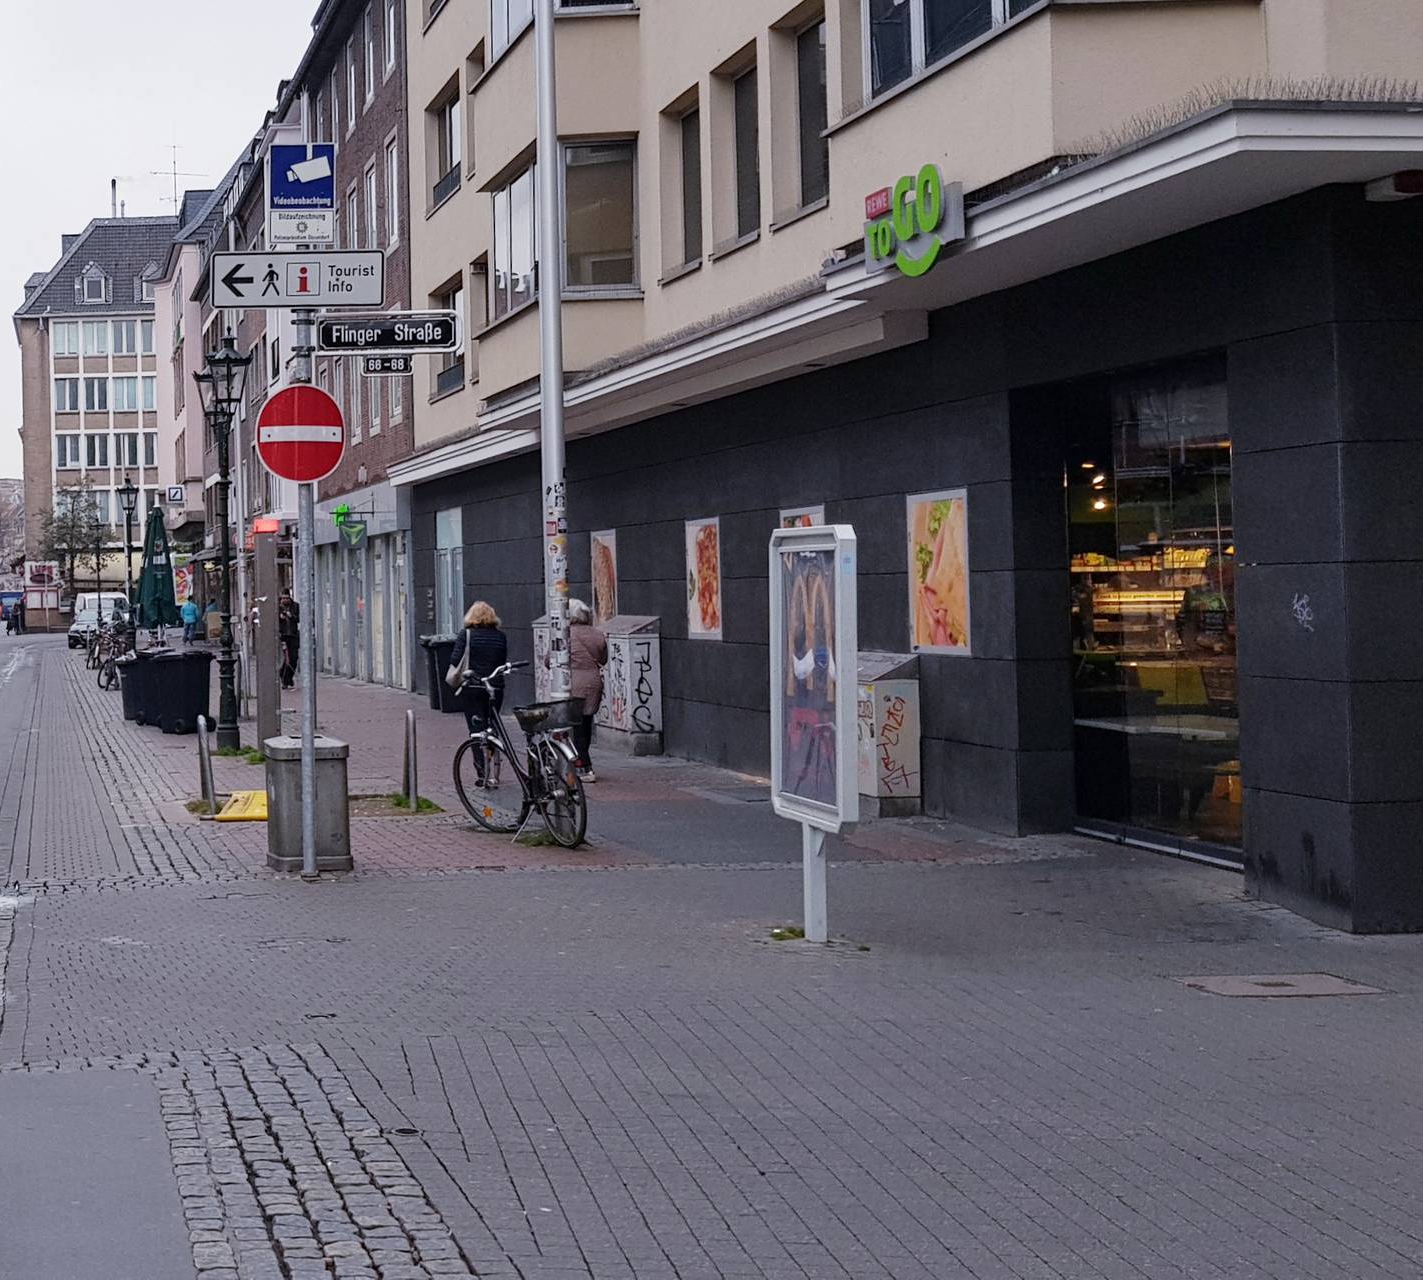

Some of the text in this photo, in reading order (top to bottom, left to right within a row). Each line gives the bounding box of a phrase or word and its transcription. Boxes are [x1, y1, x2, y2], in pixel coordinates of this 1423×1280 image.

[328, 265, 375, 277] Tourist
[328, 280, 353, 293] Info
[332, 322, 442, 346] Flinger Straße
